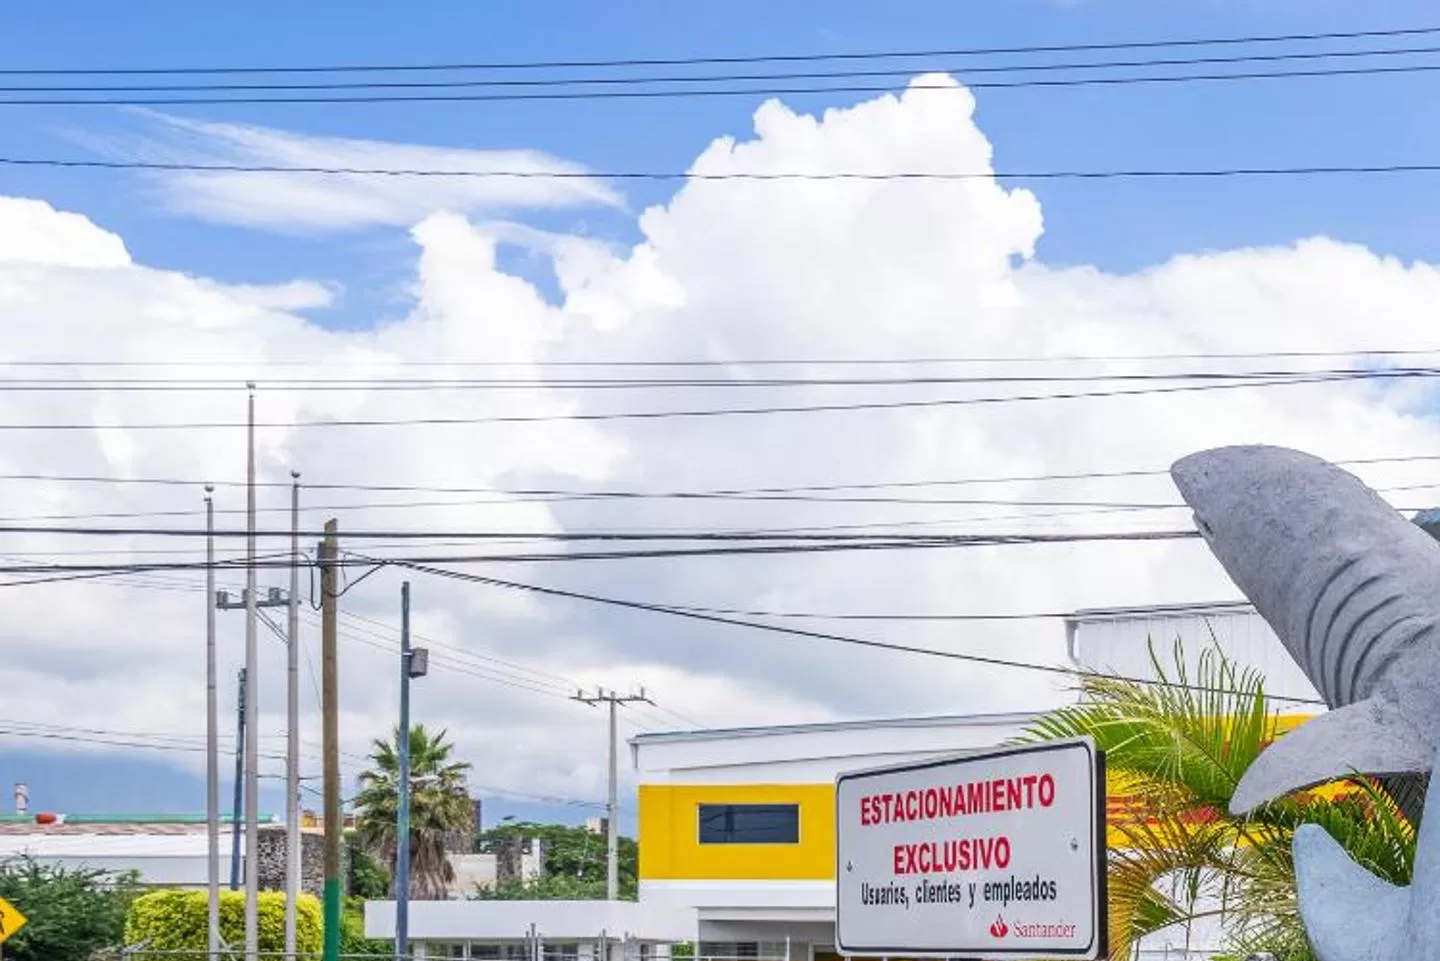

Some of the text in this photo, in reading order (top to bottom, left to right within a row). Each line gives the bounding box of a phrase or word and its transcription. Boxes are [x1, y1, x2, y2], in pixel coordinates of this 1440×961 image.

[860, 773, 1055, 826] ESTACIONAMIENTO
[893, 837, 1011, 875] EXCLUSIVO
[861, 874, 1057, 909] Usuarios, clientes y empleados
[1013, 919, 1076, 938] Santander
